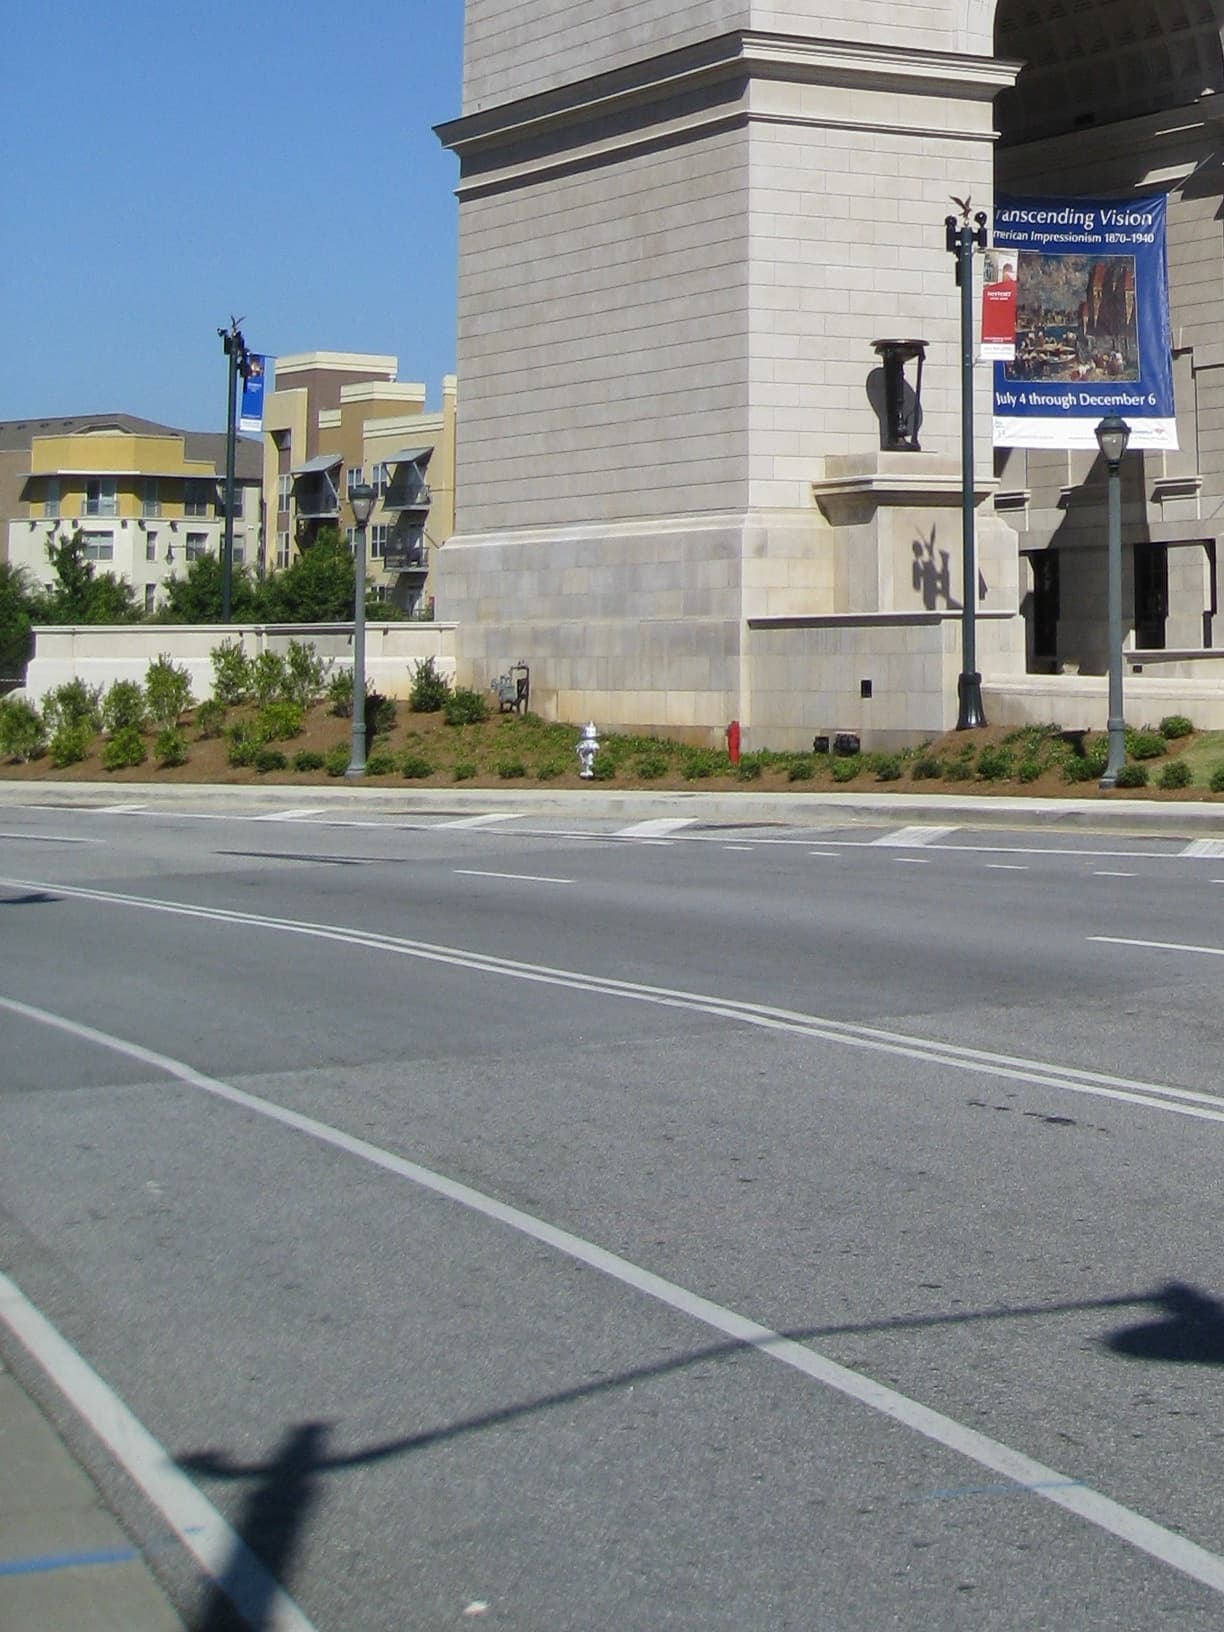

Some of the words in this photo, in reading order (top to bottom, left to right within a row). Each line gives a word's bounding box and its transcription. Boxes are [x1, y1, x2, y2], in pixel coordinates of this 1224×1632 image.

[1100, 208, 1153, 226] Vision
[993, 229, 1029, 241] merican
[1030, 230, 1102, 245] Impressionism
[995, 391, 1017, 409] July
[1018, 392, 1027, 405] 4
[1028, 391, 1077, 410] through
[1079, 392, 1146, 406] December
[1147, 392, 1157, 406] 6
